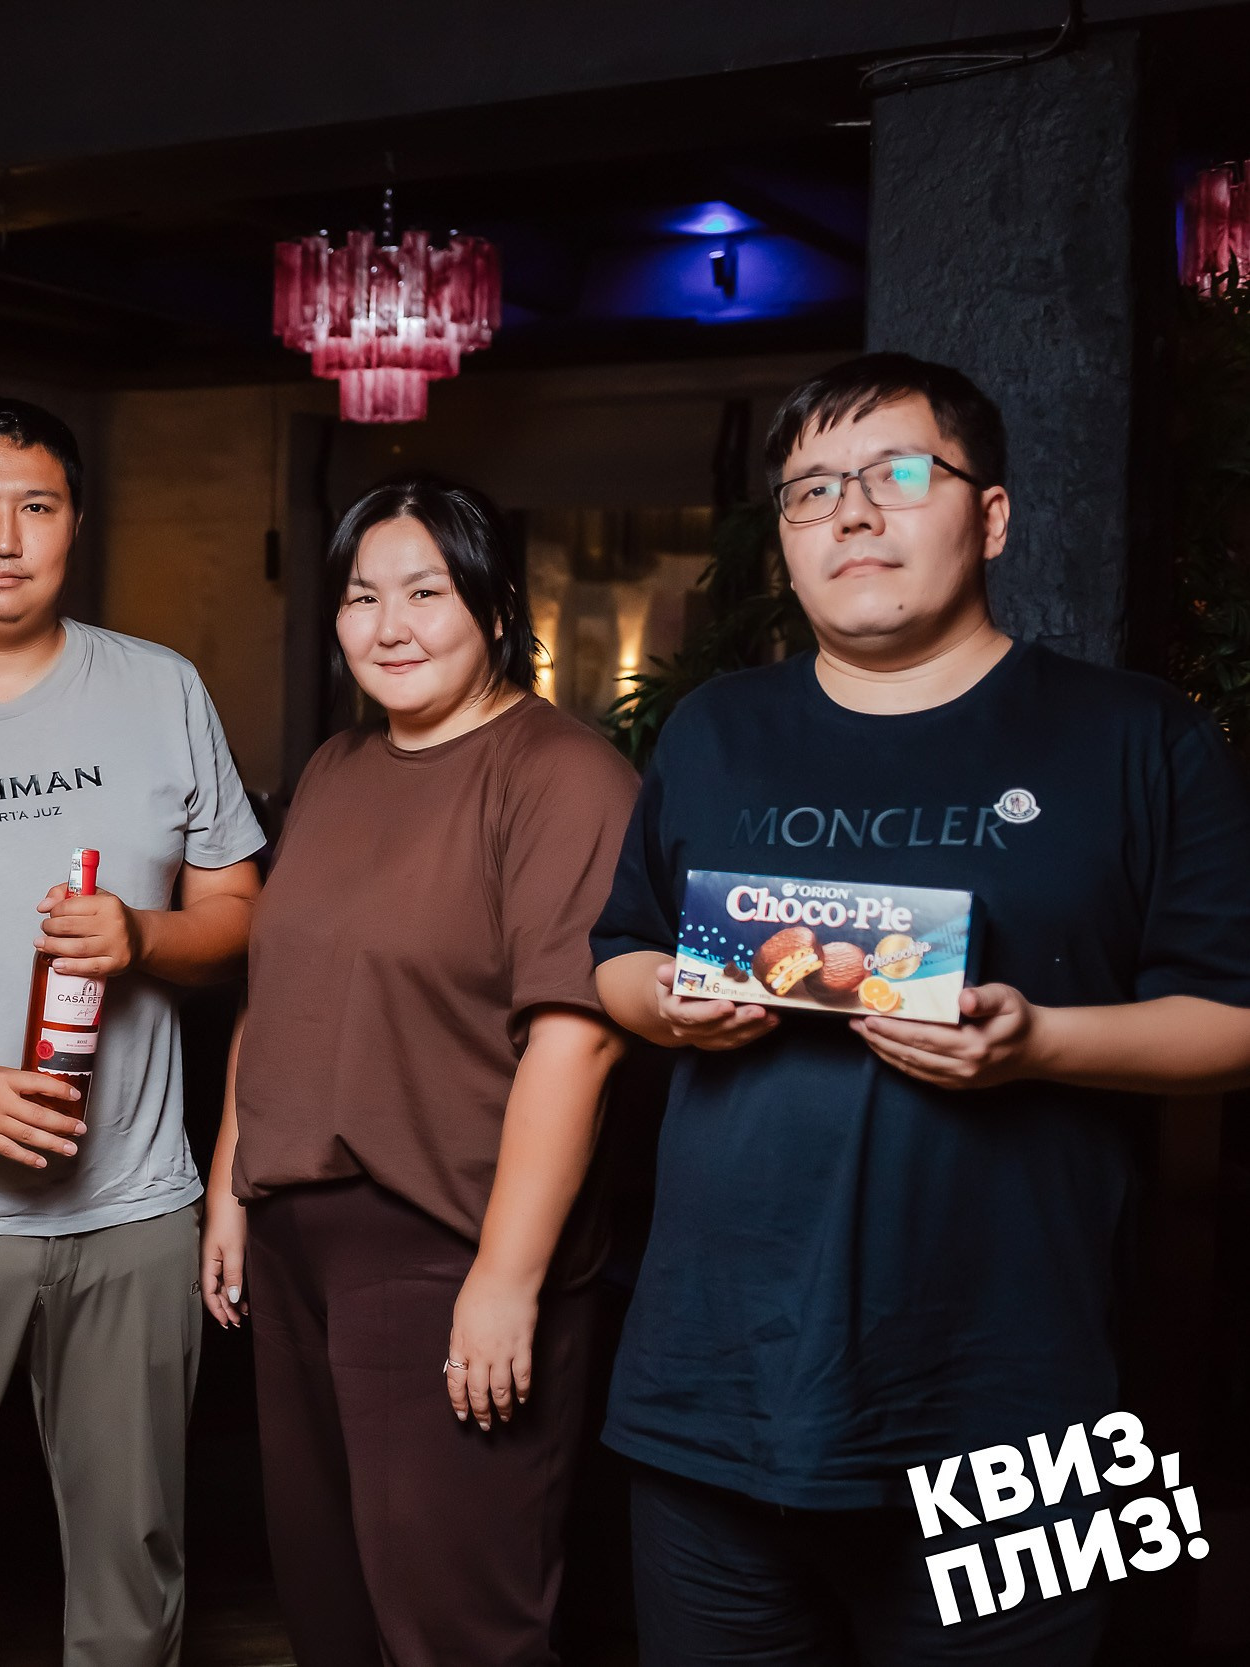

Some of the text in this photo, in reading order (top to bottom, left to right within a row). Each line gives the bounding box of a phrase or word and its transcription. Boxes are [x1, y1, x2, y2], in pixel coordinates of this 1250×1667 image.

[33, 806, 63, 818] JUZ
[729, 806, 1008, 850] MONCLER
[800, 886, 849, 900] ORION
[712, 982, 720, 993] 6
[57, 994, 85, 1004] CASA
